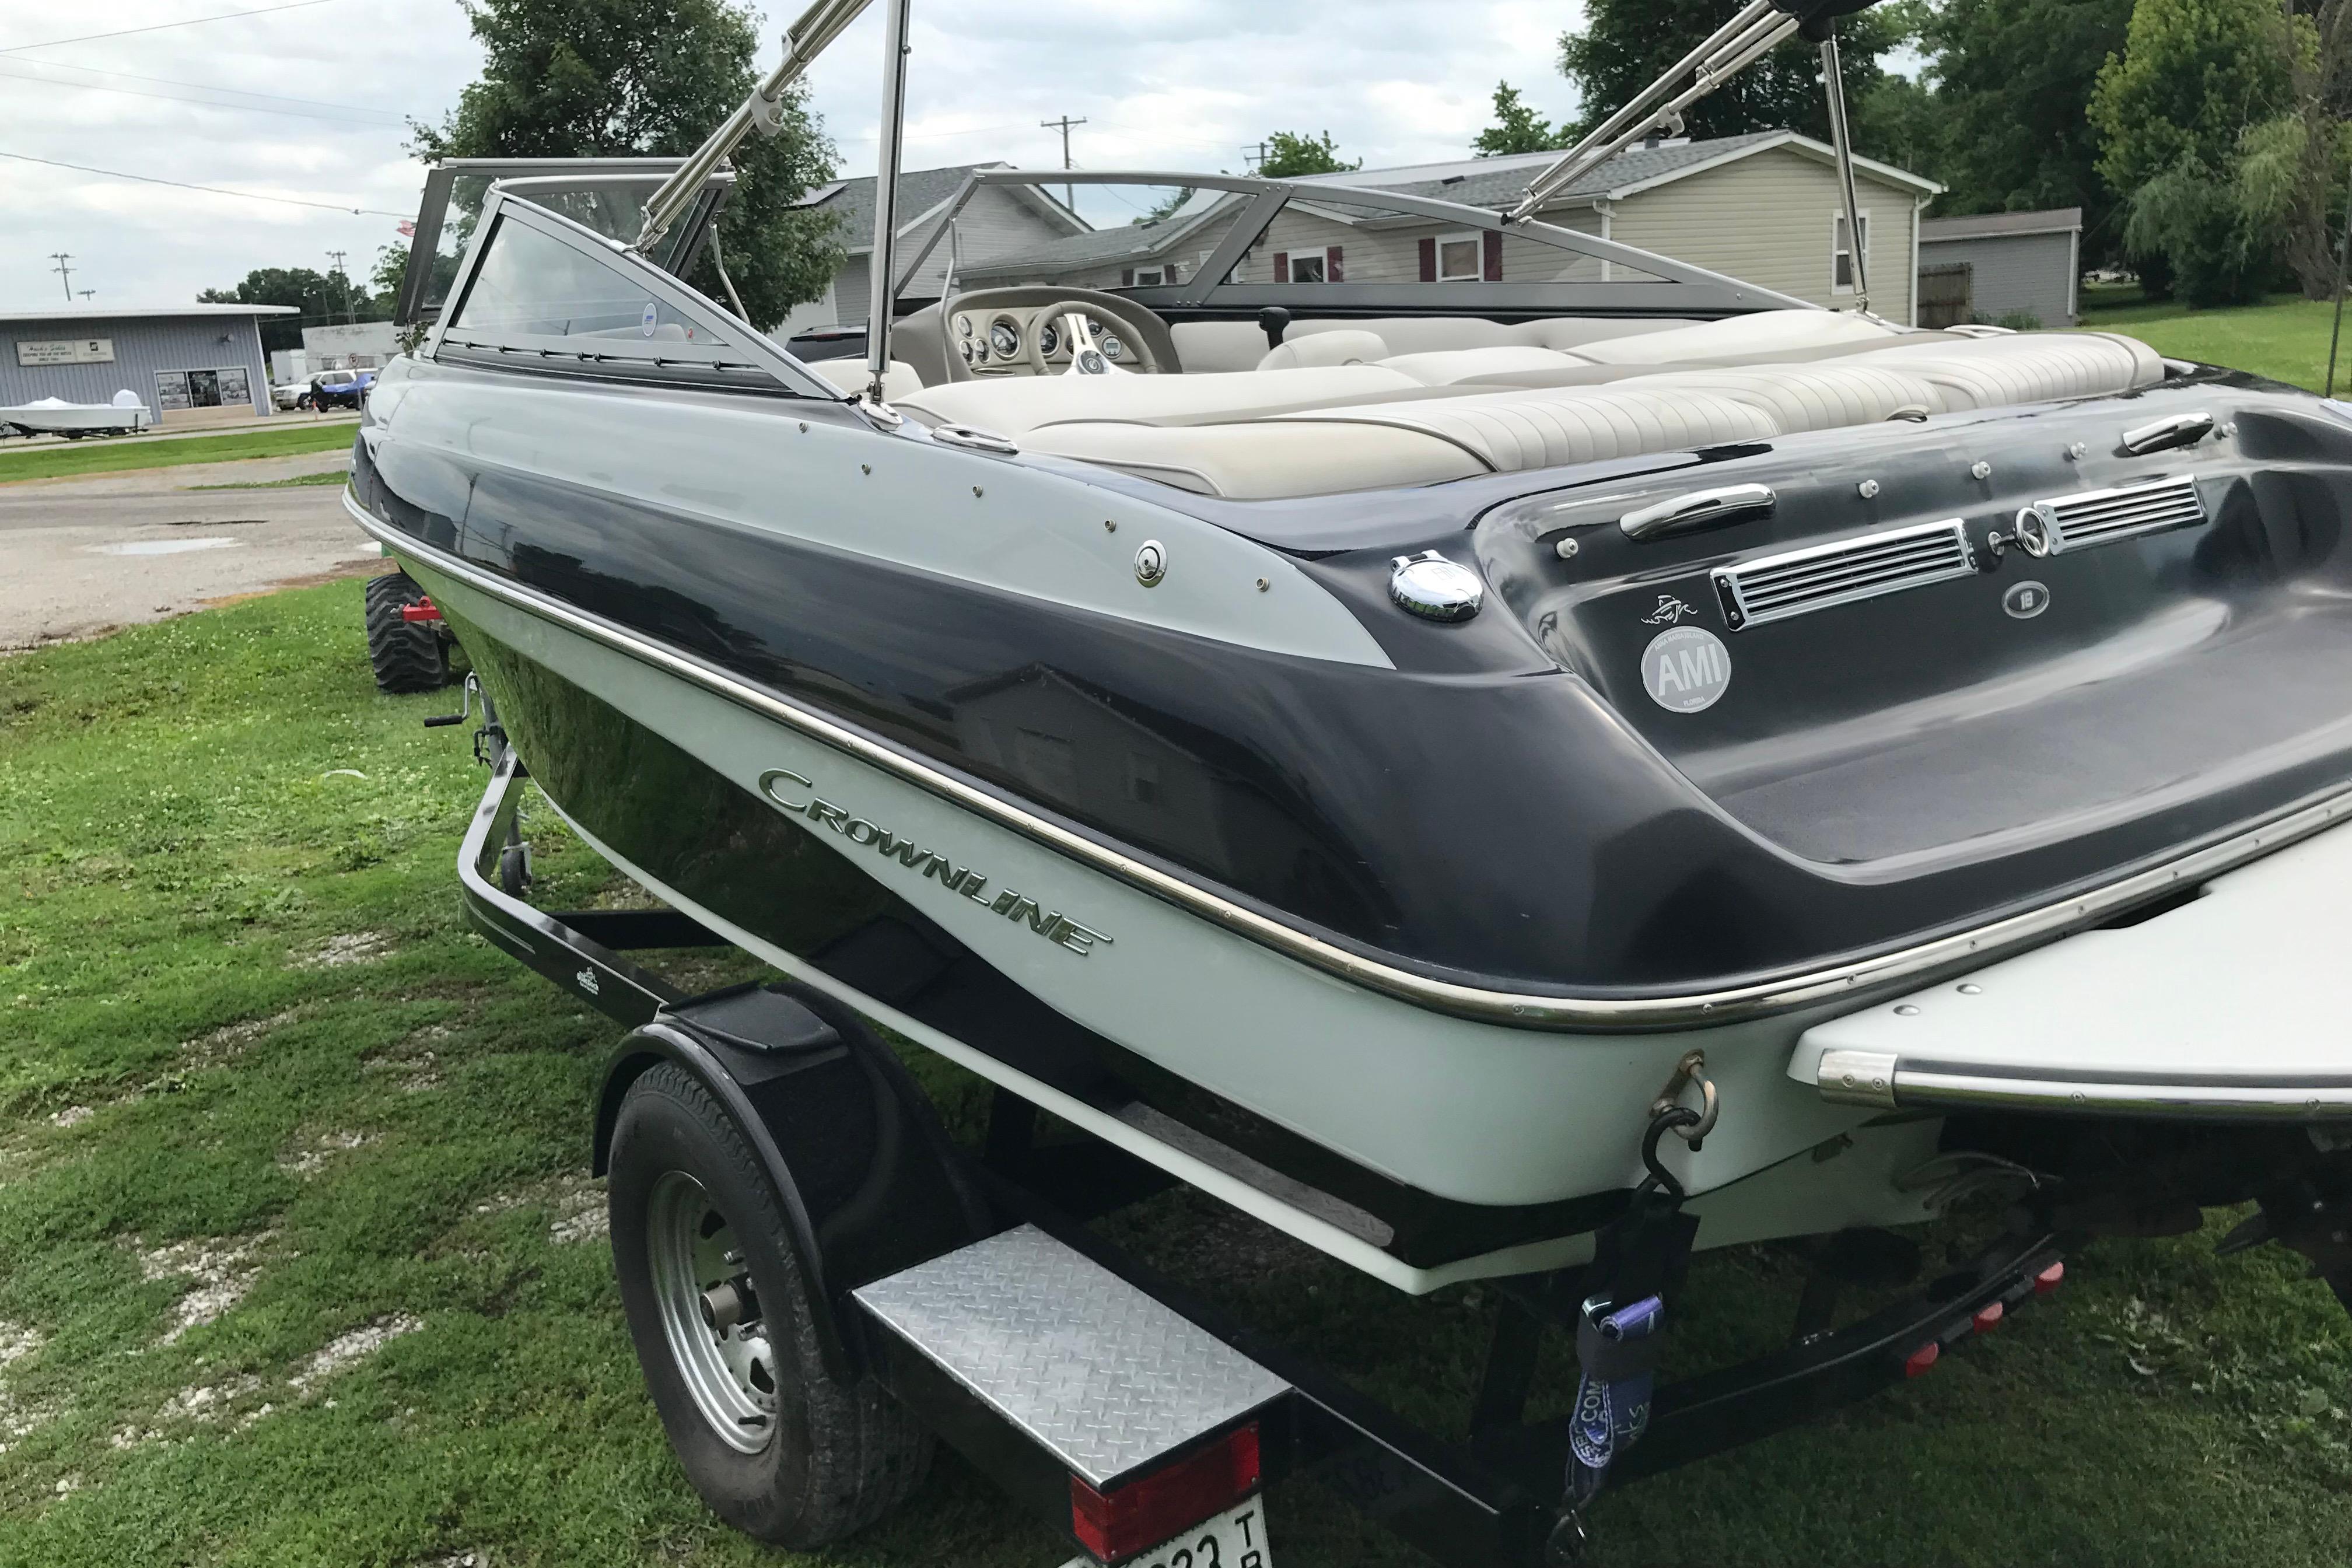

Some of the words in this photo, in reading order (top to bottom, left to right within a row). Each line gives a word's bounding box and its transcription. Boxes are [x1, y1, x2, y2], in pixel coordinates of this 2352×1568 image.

[1654, 639, 1668, 652] ANNA
[1668, 633, 1685, 642] MARIA
[1658, 643, 1722, 696] AMI
[1683, 696, 1706, 706] FLORIDA
[758, 768, 1114, 957] CROWNLINE
